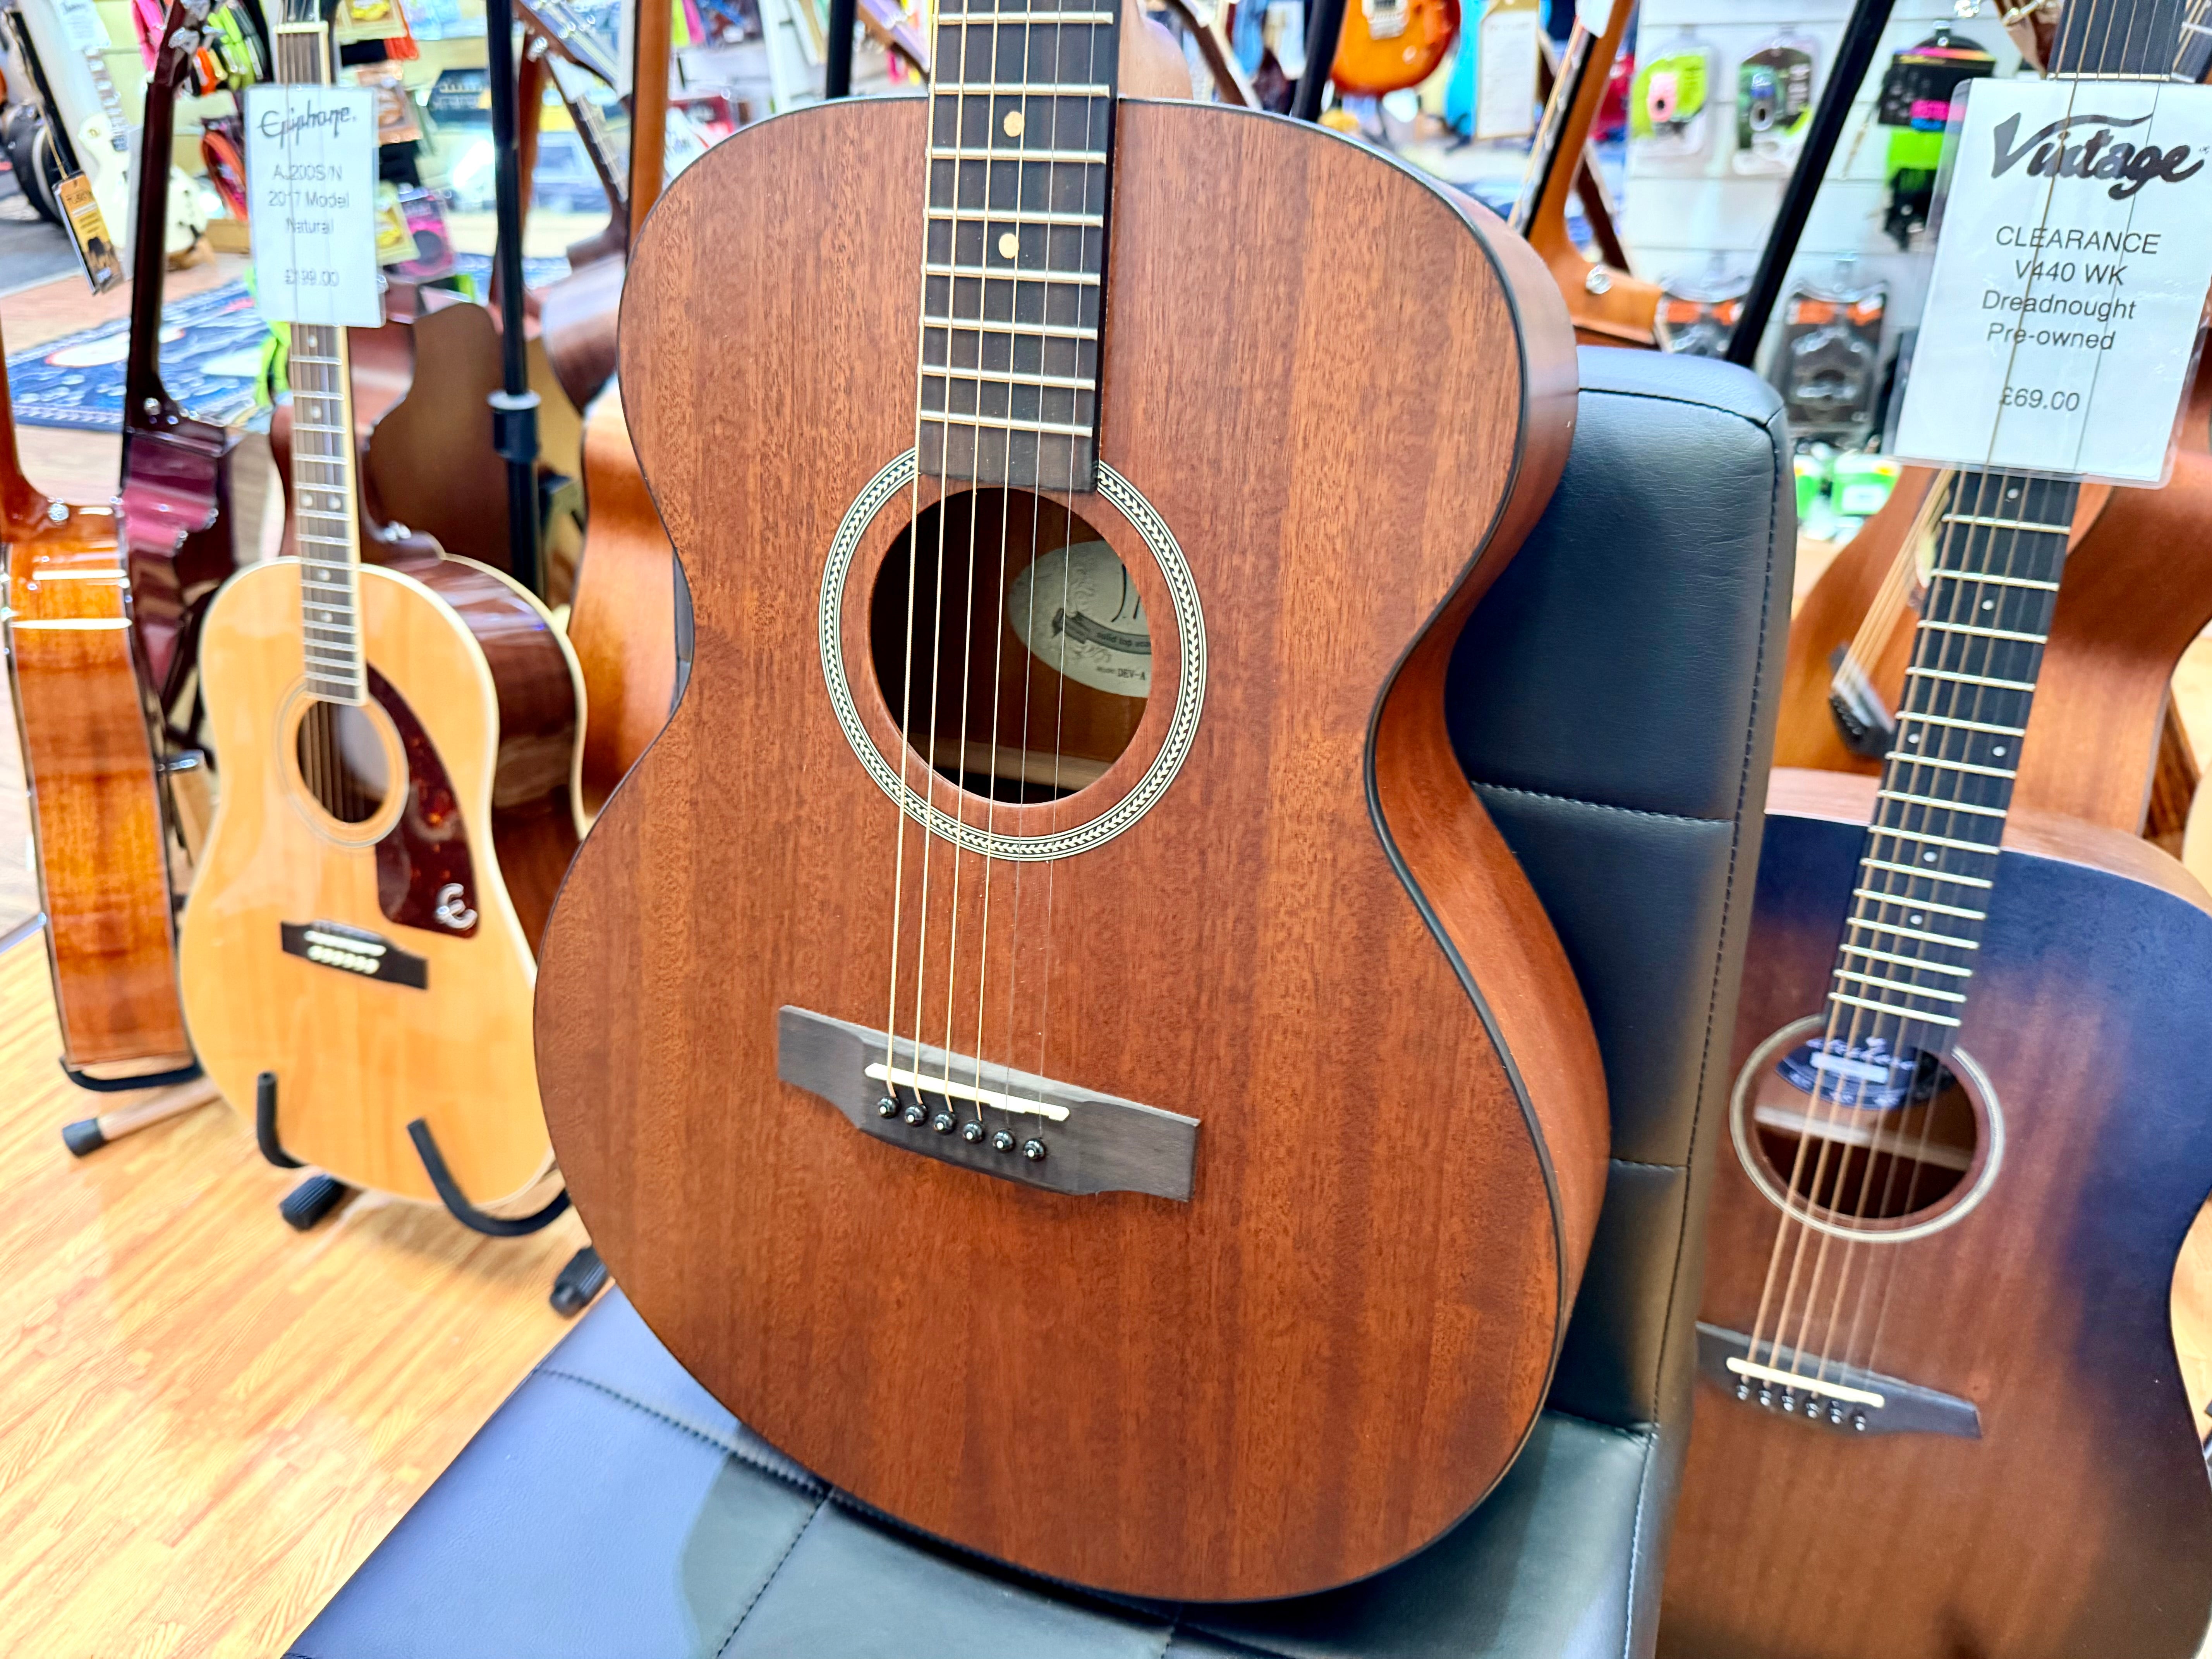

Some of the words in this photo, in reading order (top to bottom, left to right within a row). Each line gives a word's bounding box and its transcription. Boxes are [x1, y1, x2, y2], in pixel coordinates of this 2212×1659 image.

[1991, 112, 2205, 200] Vintage
[268, 189, 301, 206] 2017
[306, 189, 350, 208] Model
[285, 216, 334, 234] Natural
[1996, 225, 2161, 255] CLEARANCE
[2015, 259, 2075, 282] V440
[2085, 264, 2128, 286] WK
[1982, 290, 2136, 321] Dreadnought
[1987, 323, 2115, 350] Pre-owned
[2001, 386, 2080, 412] £69.00
